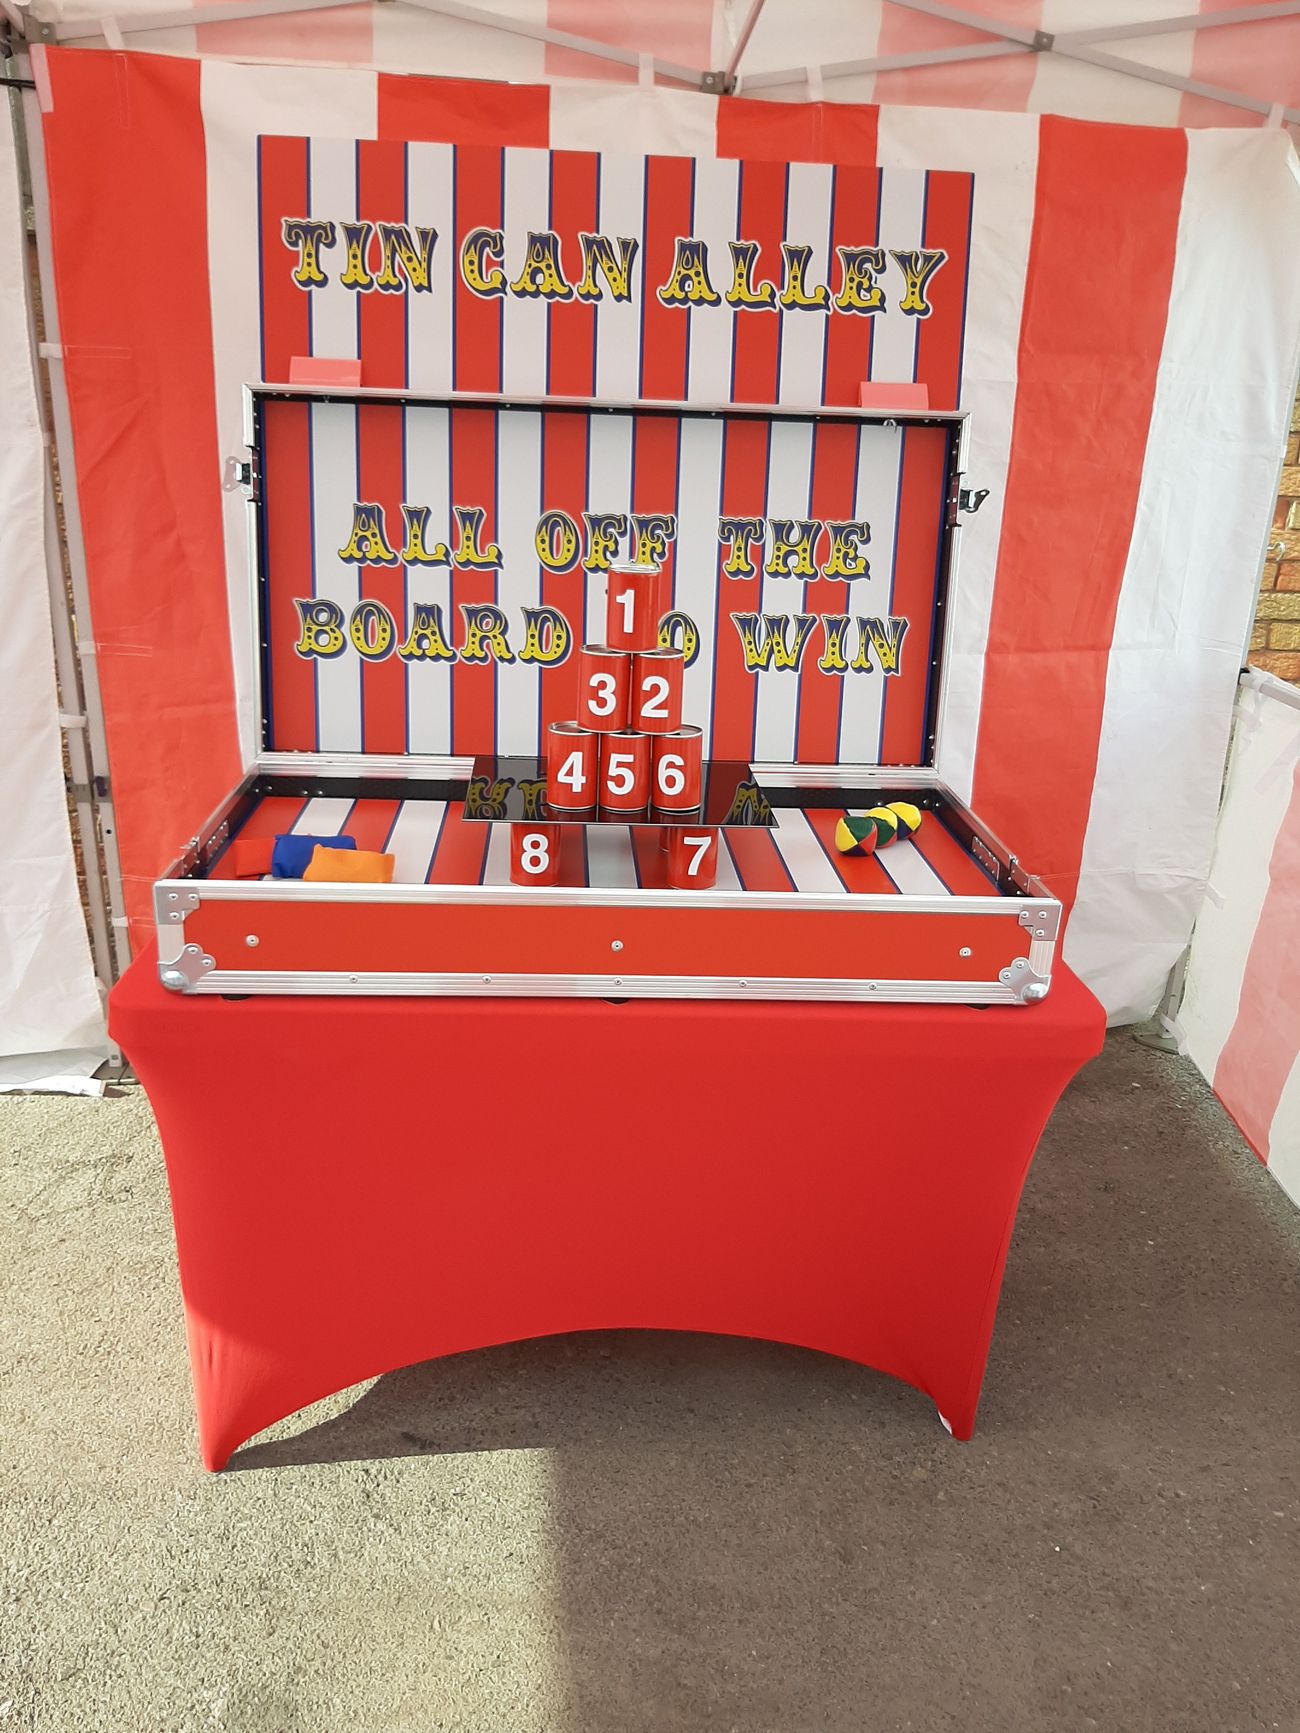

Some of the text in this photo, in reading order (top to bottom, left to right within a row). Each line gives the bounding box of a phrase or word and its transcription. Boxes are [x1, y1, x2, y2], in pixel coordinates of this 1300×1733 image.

[281, 218, 948, 318] TIN CAN ALLEY
[337, 502, 871, 580] ALL OFF THE
[615, 589, 636, 634] 1
[294, 598, 572, 666] BOARD
[730, 613, 908, 675] WIN
[588, 672, 617, 717] 3
[640, 675, 670, 719] 2
[556, 751, 586, 793] 4
[606, 753, 635, 796] 5
[657, 754, 686, 796] 6
[520, 833, 550, 875] 8
[683, 836, 712, 876] 7
